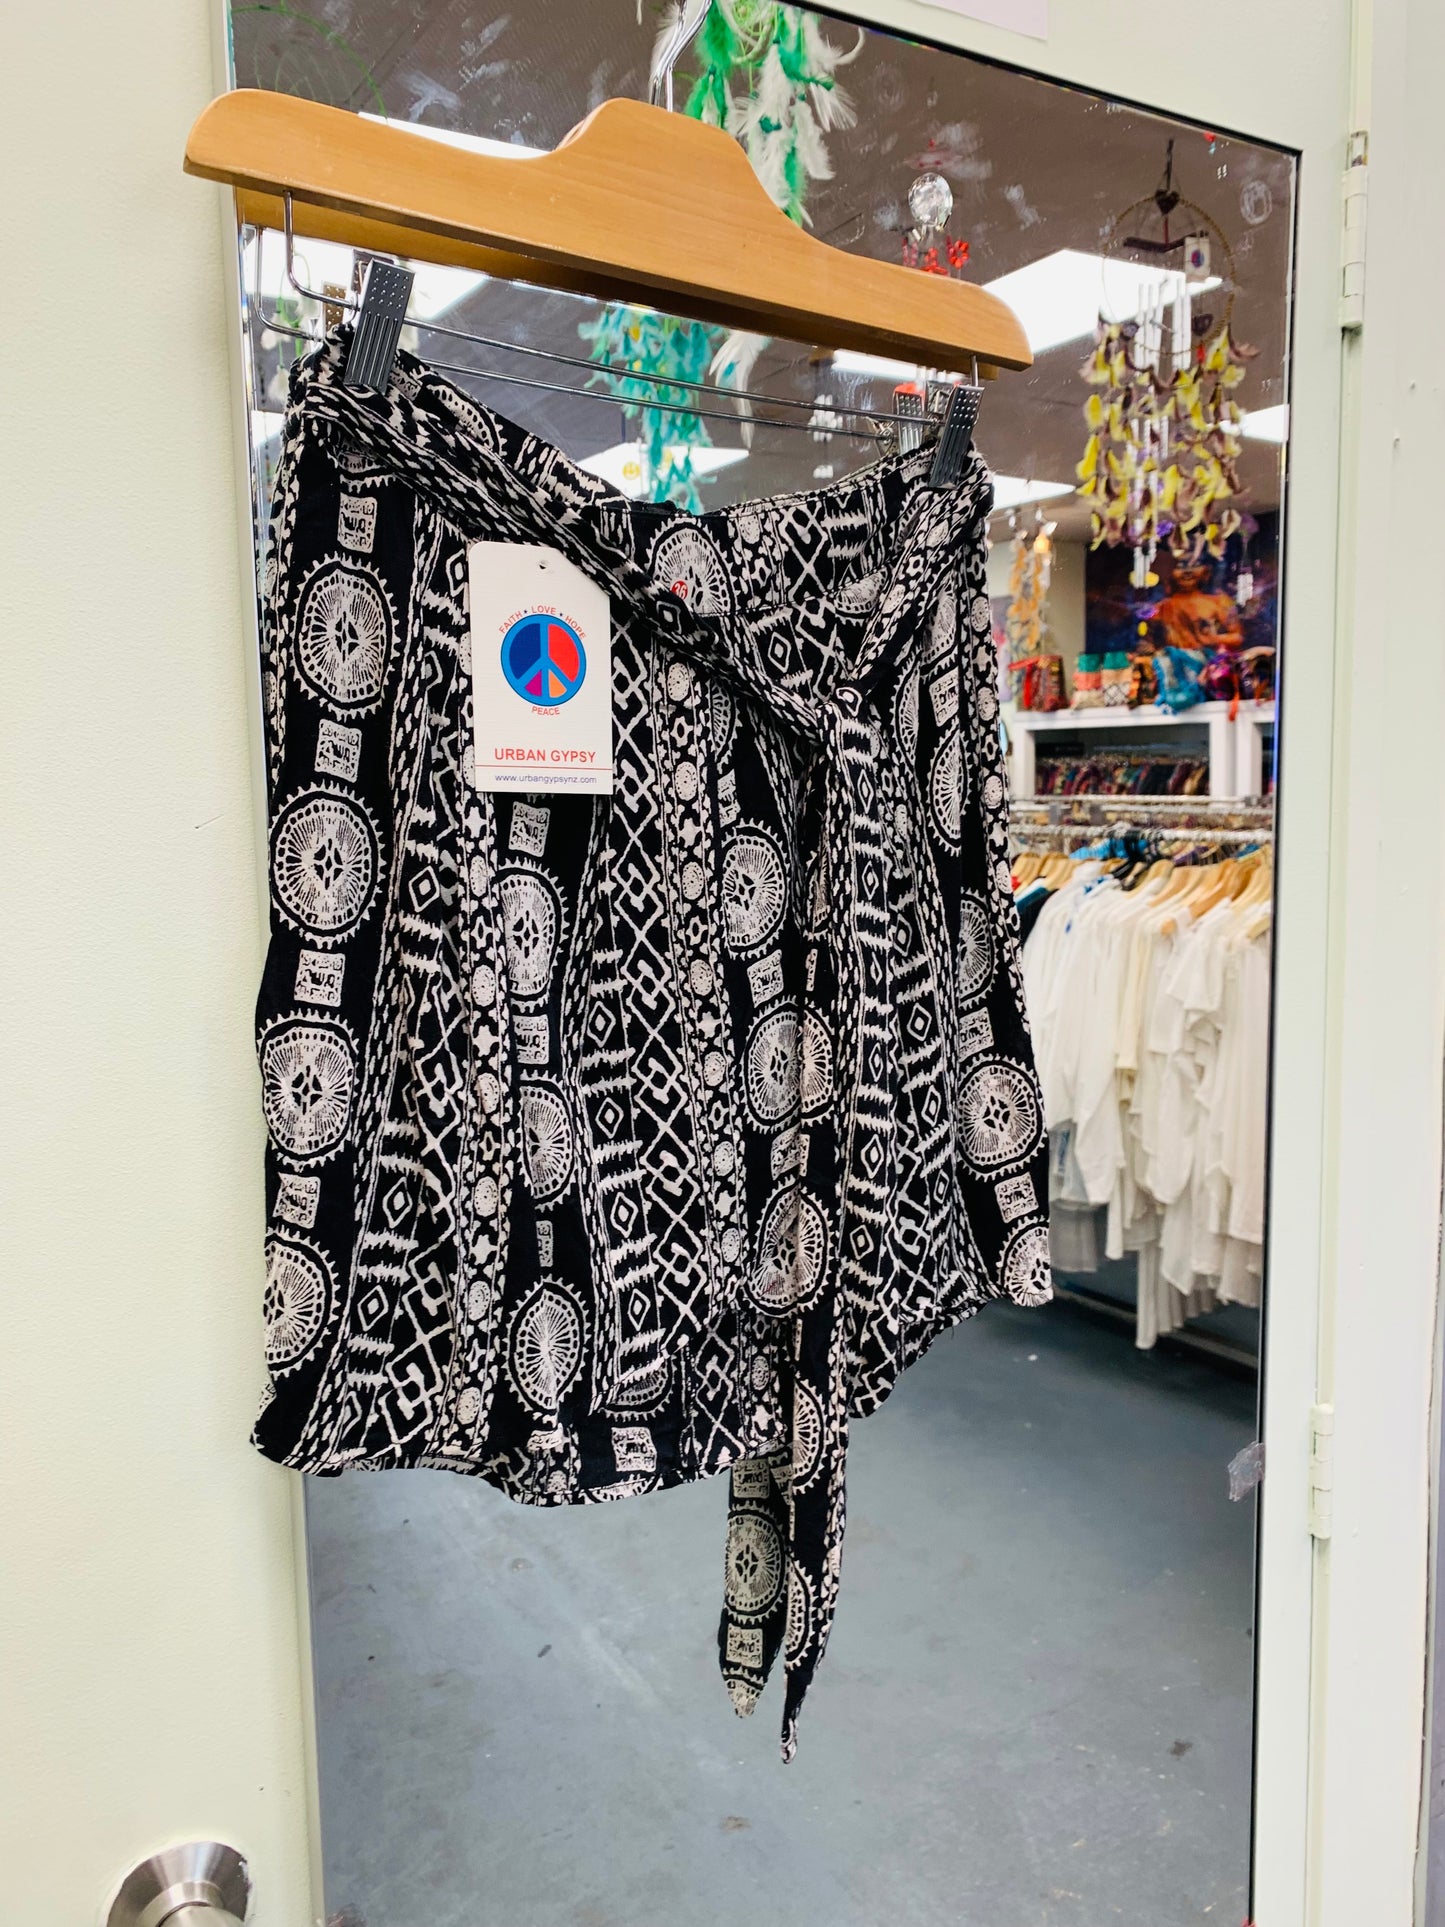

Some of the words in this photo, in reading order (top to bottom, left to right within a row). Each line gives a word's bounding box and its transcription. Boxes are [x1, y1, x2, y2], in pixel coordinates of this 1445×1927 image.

[498, 610, 523, 634] FAITH
[531, 605, 557, 616] LOVE
[565, 615, 587, 640] HOPE
[531, 706, 561, 716] PEACE
[494, 747, 546, 762] URBAN
[550, 749, 597, 763] GYPSY
[494, 774, 597, 785] www.urbangypsynz.com
